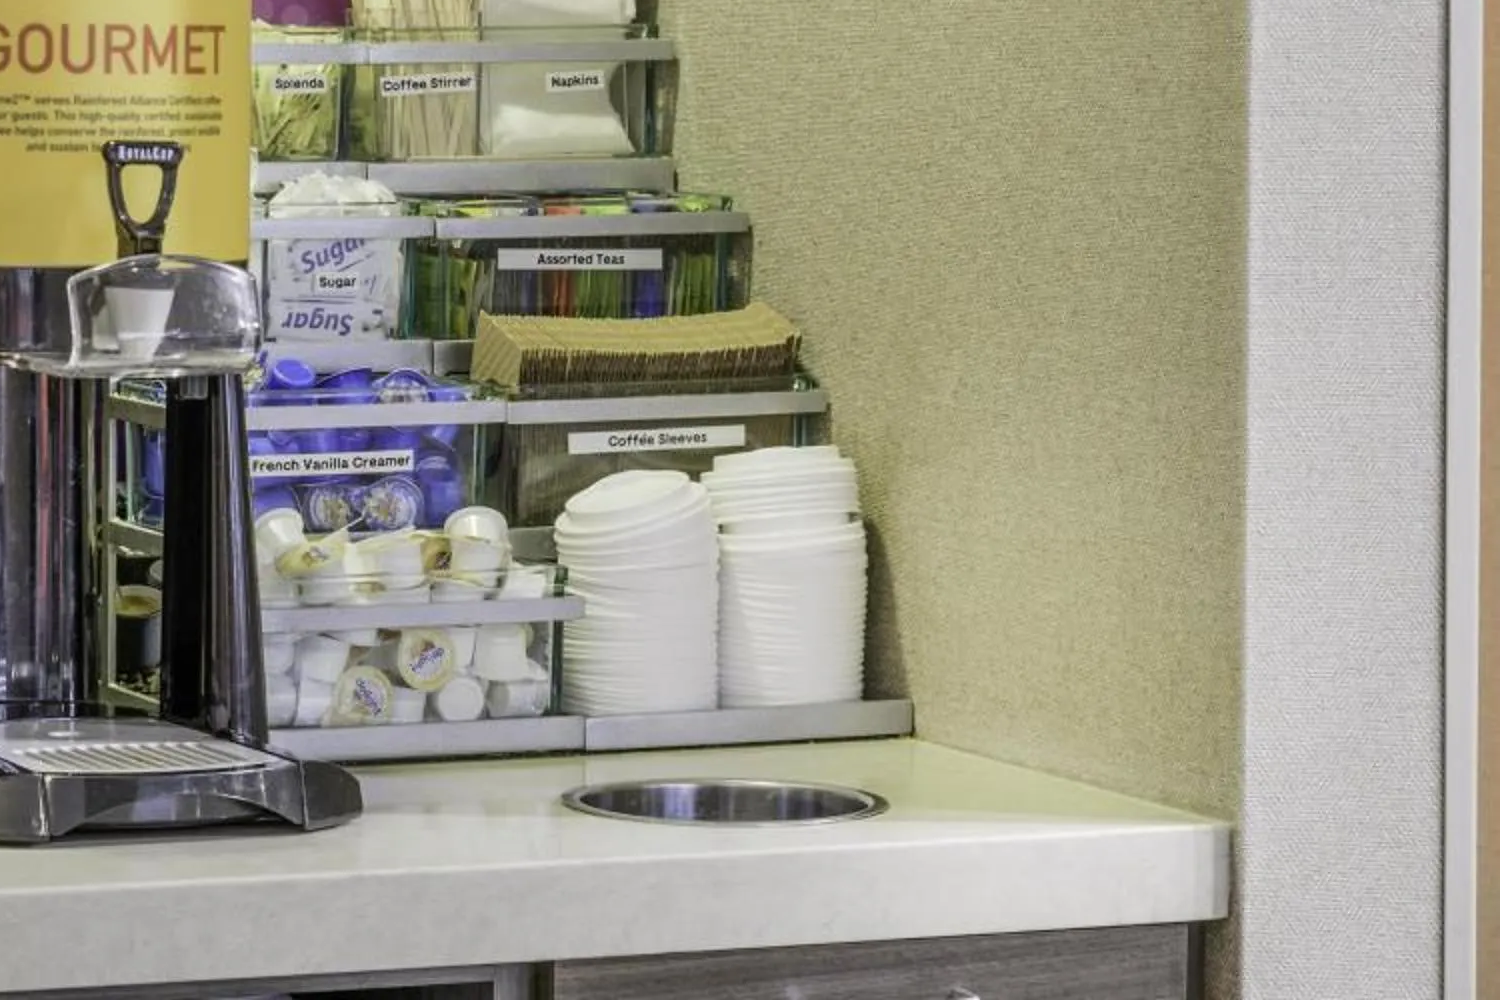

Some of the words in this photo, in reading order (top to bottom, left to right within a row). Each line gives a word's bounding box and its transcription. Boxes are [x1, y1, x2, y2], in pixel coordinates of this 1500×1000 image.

[275, 77, 325, 90] Splenda
[383, 80, 426, 92] Coffee
[430, 77, 471, 89] Stirrer
[551, 74, 599, 89] Napkins
[301, 238, 366, 275] Sugar
[537, 252, 593, 265] Assorted
[596, 253, 625, 265] Teas
[319, 275, 357, 290] Sugar
[281, 307, 354, 337] Sugar
[607, 434, 655, 447] Coffee
[658, 432, 708, 446] Sleeves
[253, 458, 300, 472] French
[303, 457, 349, 471] Vanilla
[351, 454, 411, 470] Creamer
